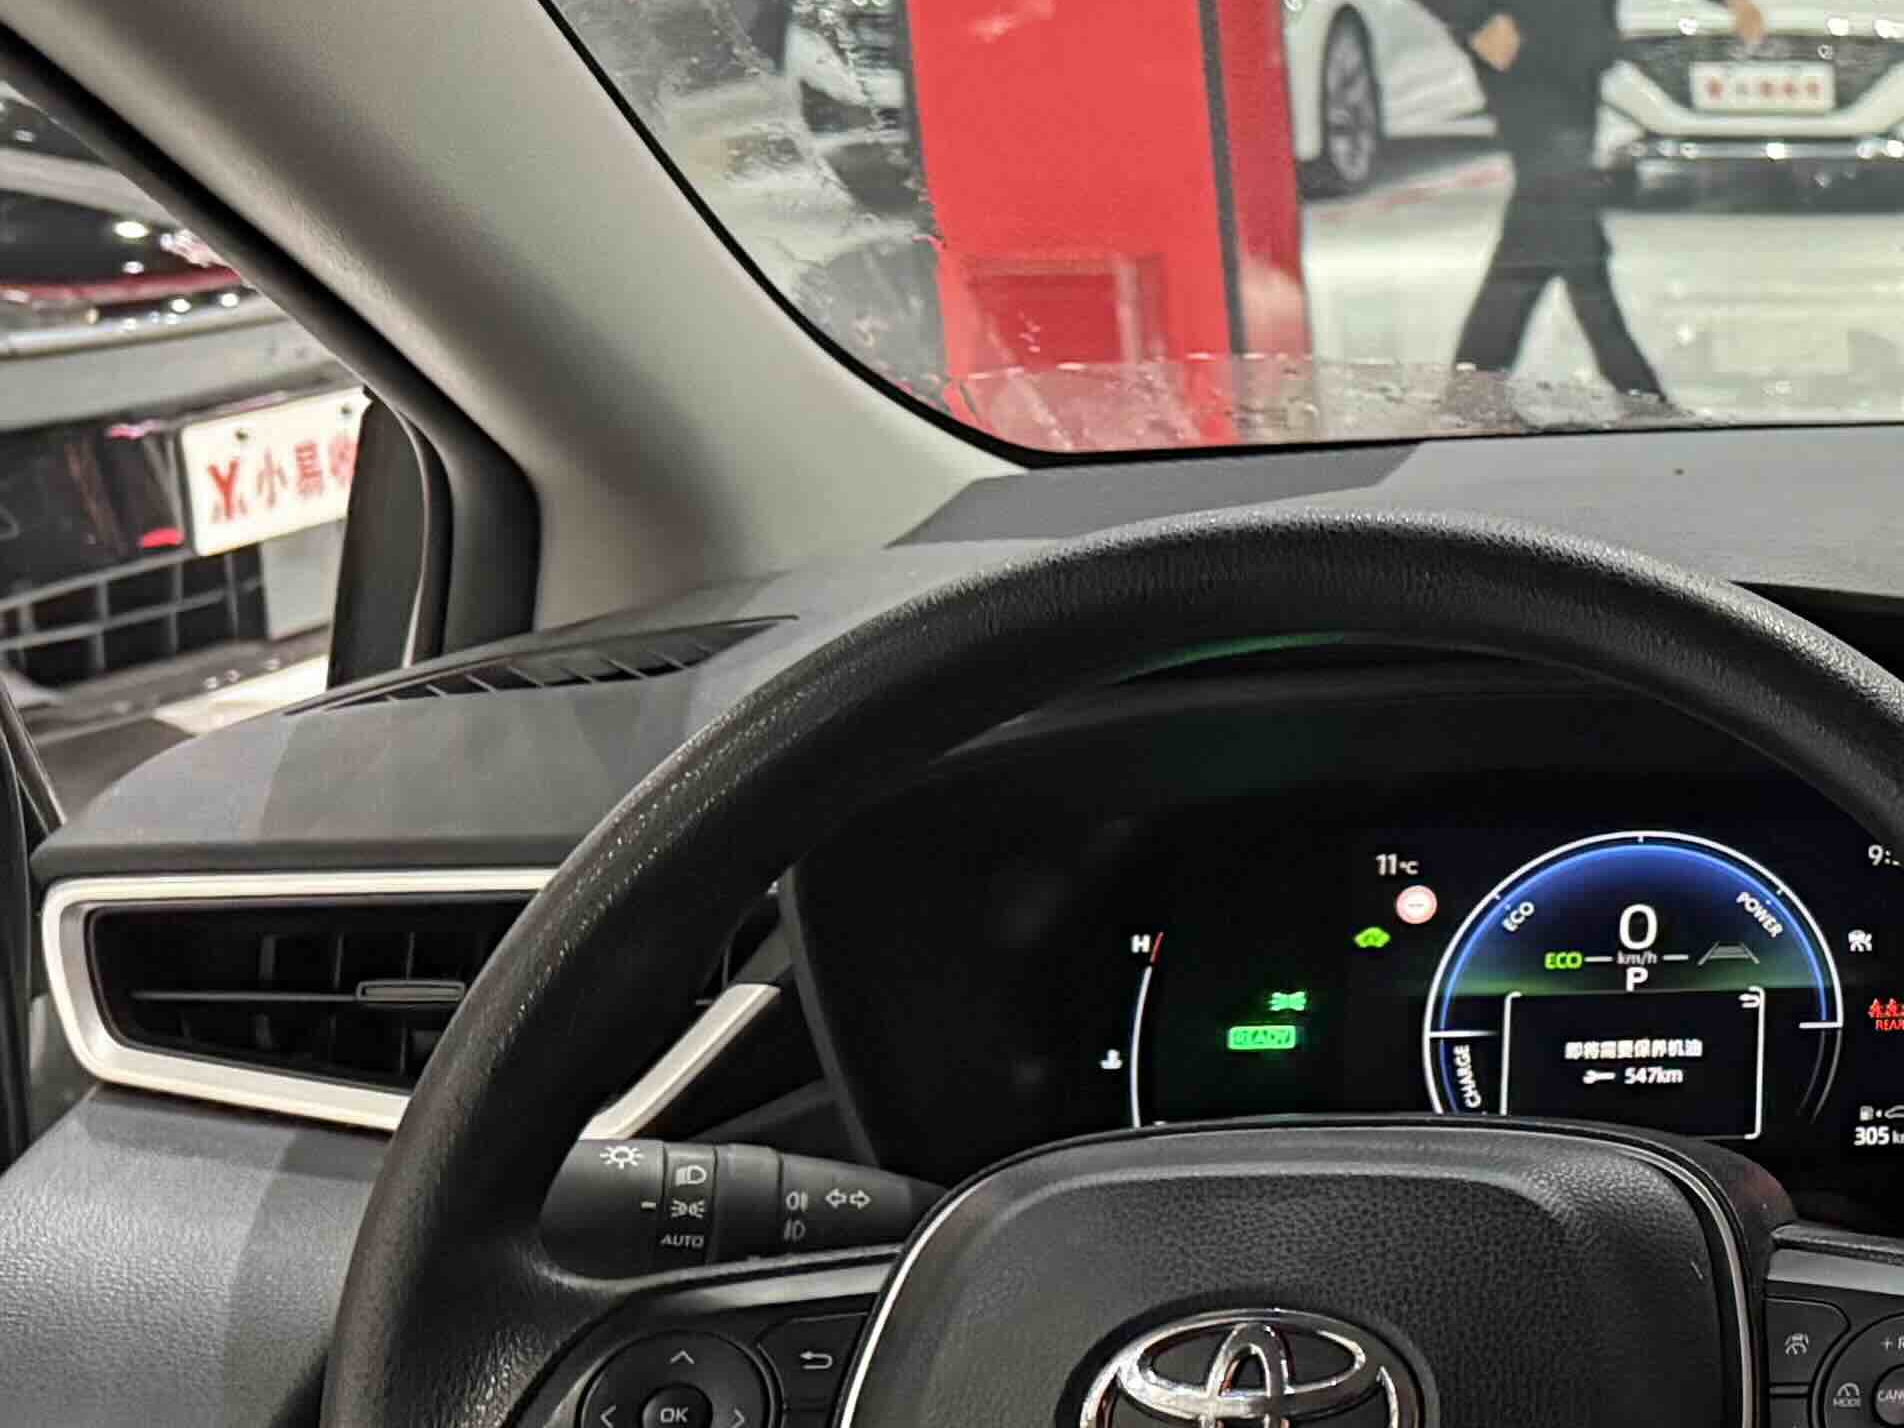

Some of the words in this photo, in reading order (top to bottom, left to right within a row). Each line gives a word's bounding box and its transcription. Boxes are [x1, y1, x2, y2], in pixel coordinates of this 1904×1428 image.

[1503, 901, 1536, 933] ECO
[1736, 891, 1784, 939] POWER
[1618, 904, 1658, 951] 0
[1131, 935, 1151, 954] H
[1544, 952, 1582, 970] ECO
[1616, 951, 1658, 966] km/h
[1626, 968, 1648, 992] P
[1453, 1043, 1481, 1109] CHARGE
[1854, 1126, 1890, 1146] 305
[660, 1232, 705, 1249] AUTO
[660, 1406, 689, 1424] OK
